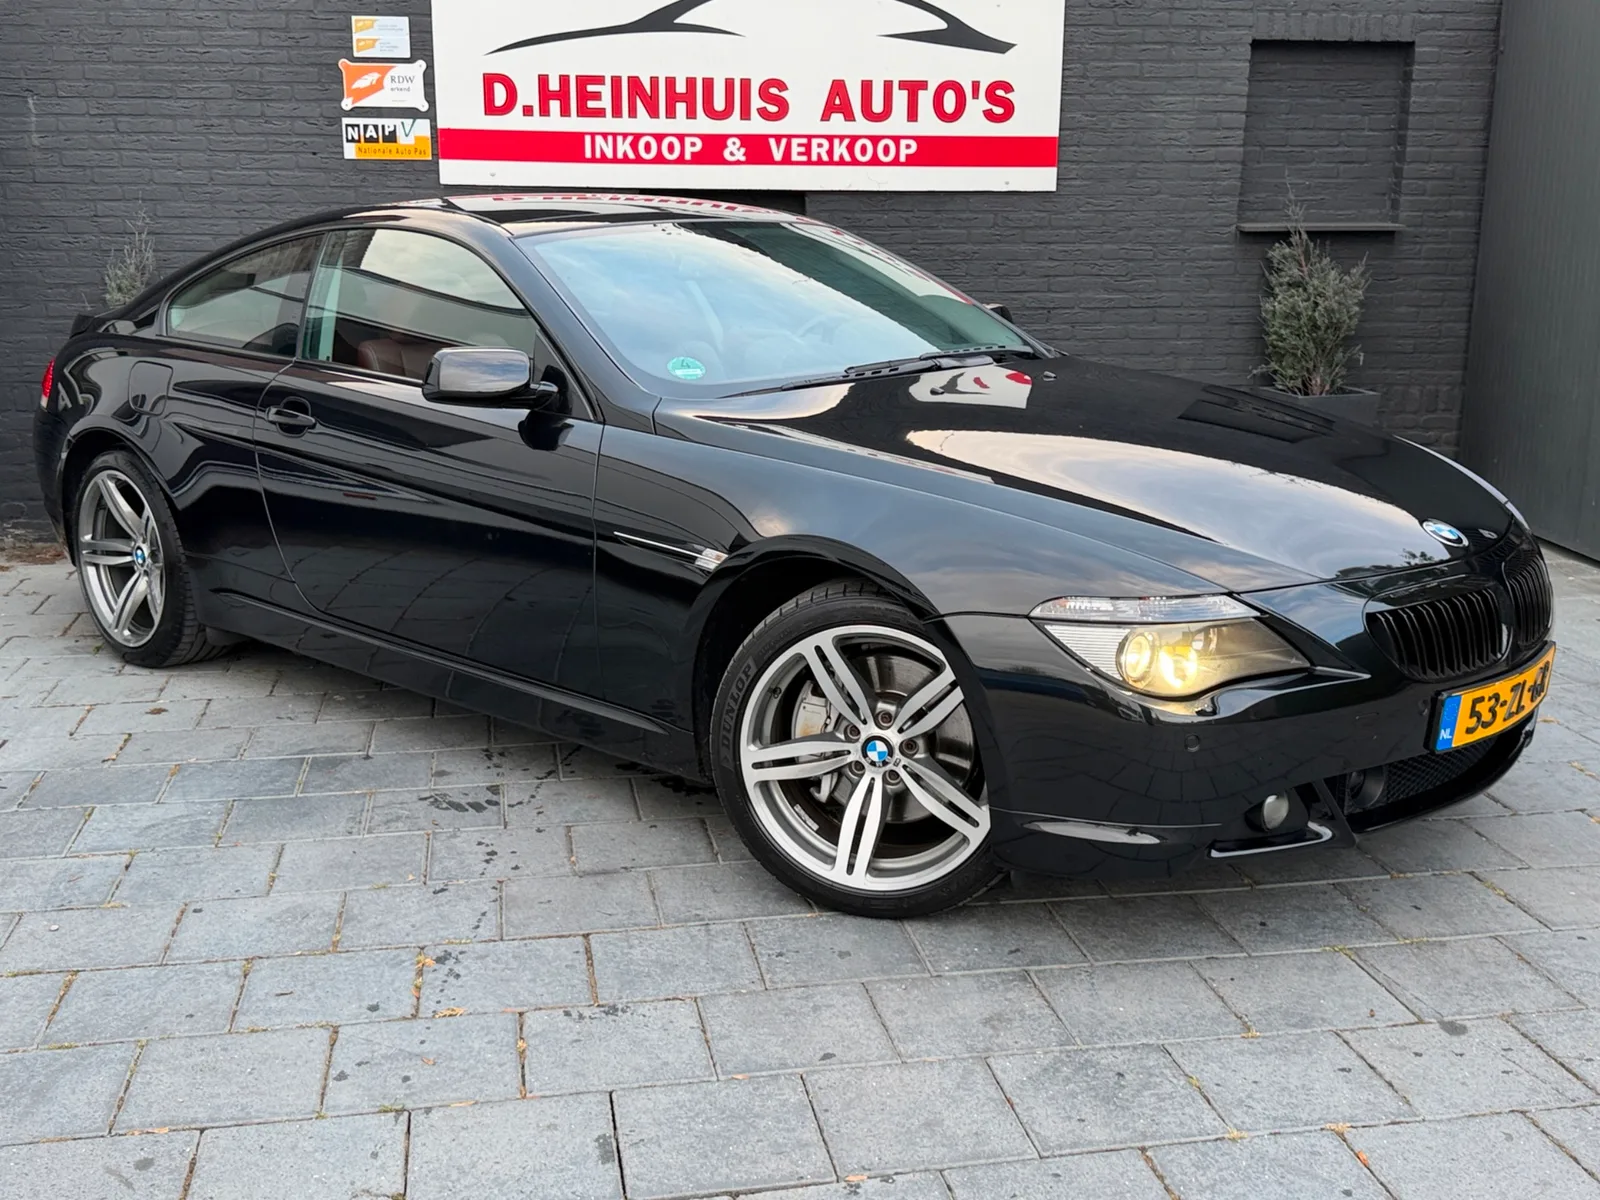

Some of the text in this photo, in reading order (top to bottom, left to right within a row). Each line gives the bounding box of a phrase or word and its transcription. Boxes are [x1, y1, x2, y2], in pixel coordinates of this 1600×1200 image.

[390, 75, 415, 84] RDW
[483, 73, 1015, 123] D.HEINHUIS AUTO'S
[358, 146, 427, 155] Nationale Auto Pas
[584, 134, 918, 162] INKOOP & VERKOOP
[721, 663, 753, 750] DUNLOP
[1440, 728, 1452, 740] NL
